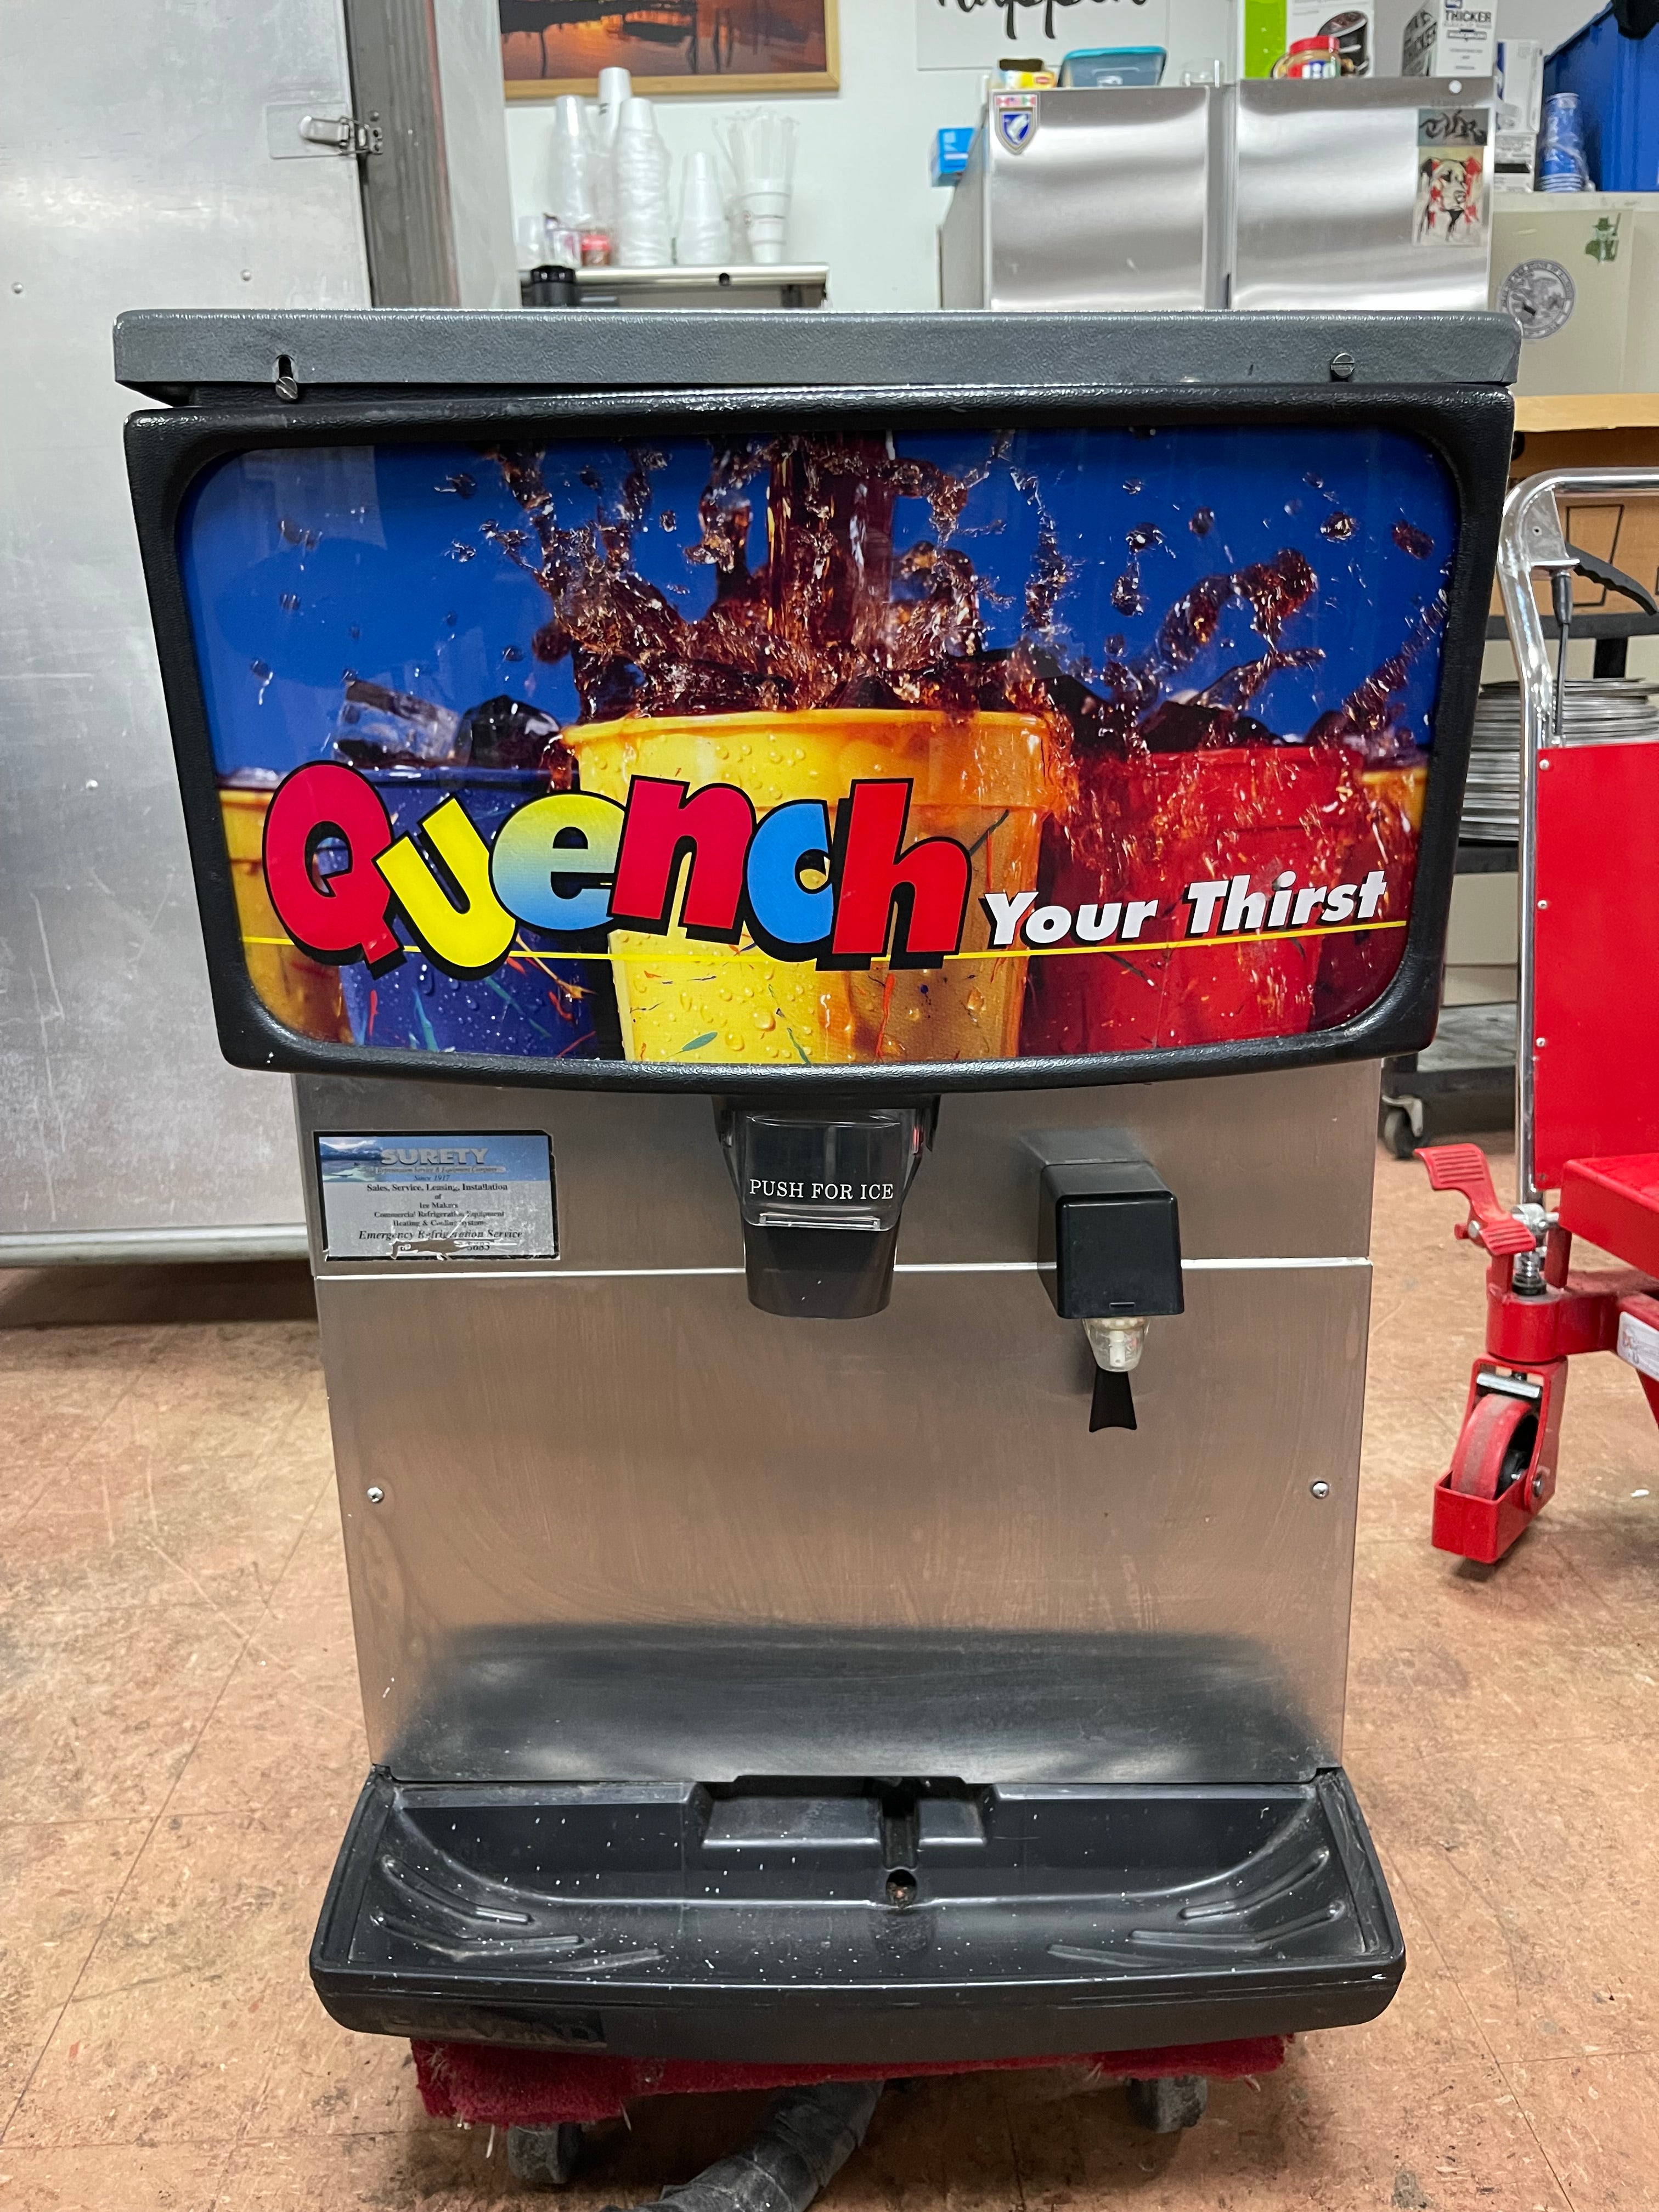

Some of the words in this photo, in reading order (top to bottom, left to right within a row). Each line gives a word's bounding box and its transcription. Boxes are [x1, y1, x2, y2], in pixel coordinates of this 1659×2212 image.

[262, 760, 973, 981] Quench
[980, 891, 1159, 951] Your
[1182, 870, 1387, 939] Thirst
[381, 1148, 488, 1165] SURETY
[426, 1183, 460, 1192] Leasing,
[749, 1179, 804, 1198] PUSH
[811, 1183, 854, 1200] FOR
[860, 1183, 894, 1200] ICE
[487, 1229, 523, 1238] Service
